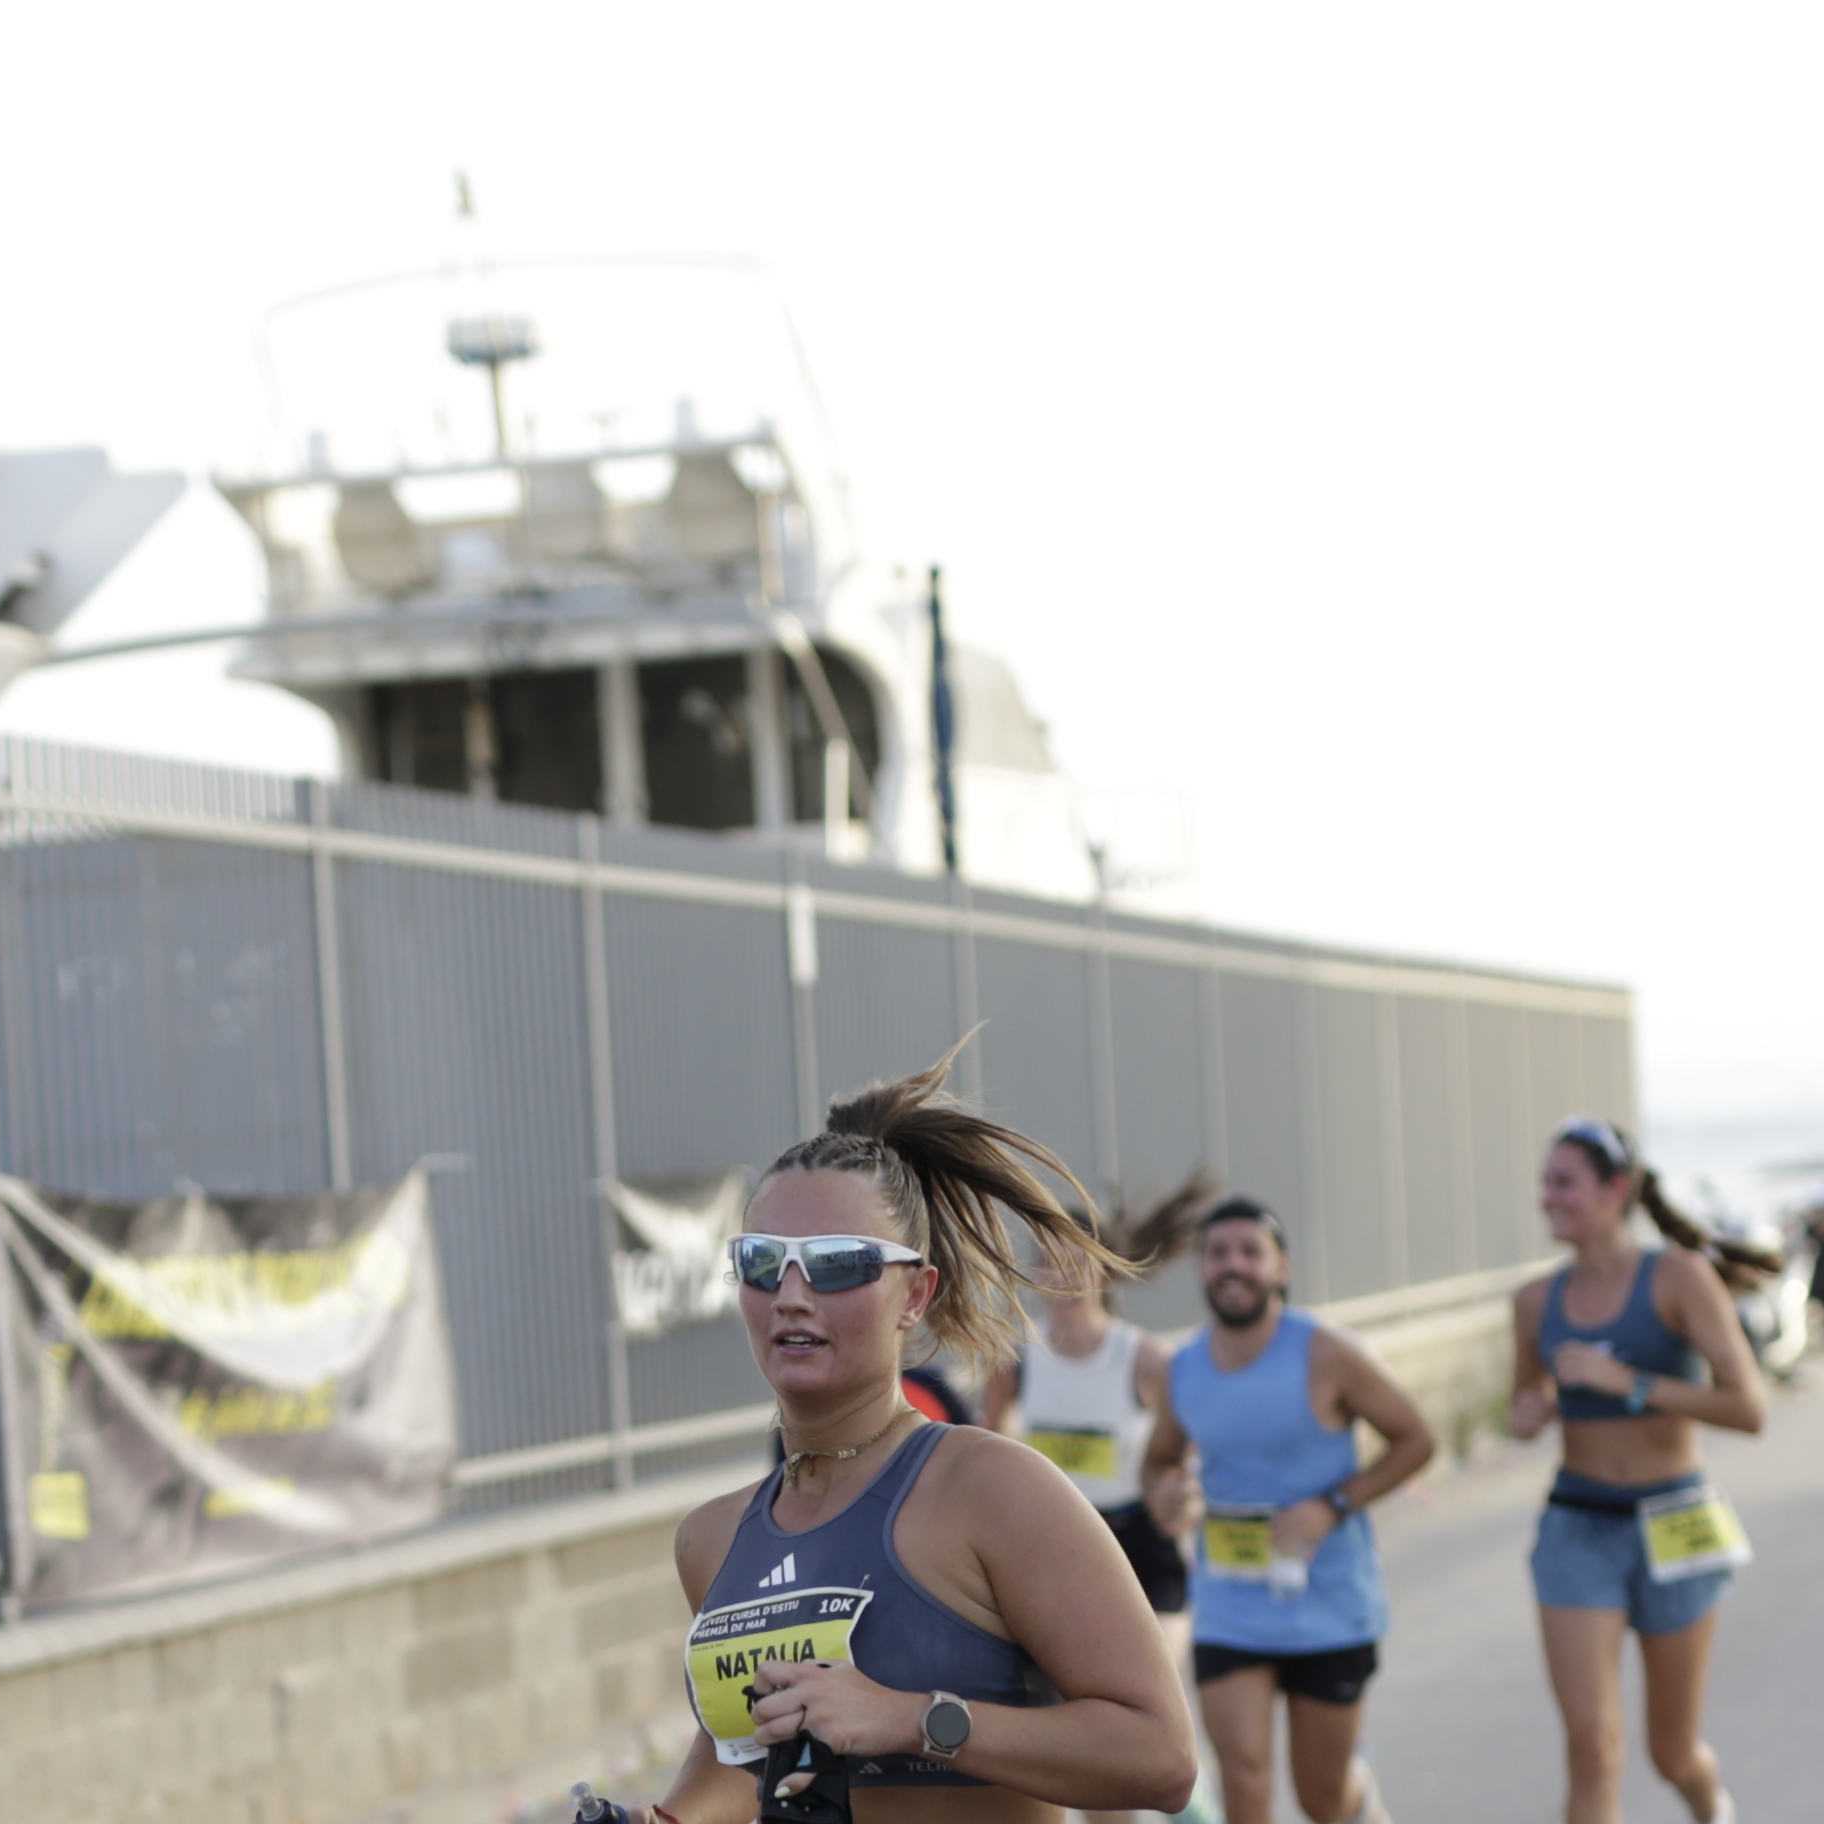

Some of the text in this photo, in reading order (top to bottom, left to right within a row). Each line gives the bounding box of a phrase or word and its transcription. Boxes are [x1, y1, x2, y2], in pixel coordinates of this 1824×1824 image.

[730, 1607, 760, 1622] CURSA
[762, 1600, 800, 1616] D'ESTIU
[818, 1597, 855, 1614] 10K
[693, 1618, 767, 1640] PREMIÀ DE MAR
[715, 1637, 816, 1681] NATALIA
[906, 1761, 952, 1772] TECH
